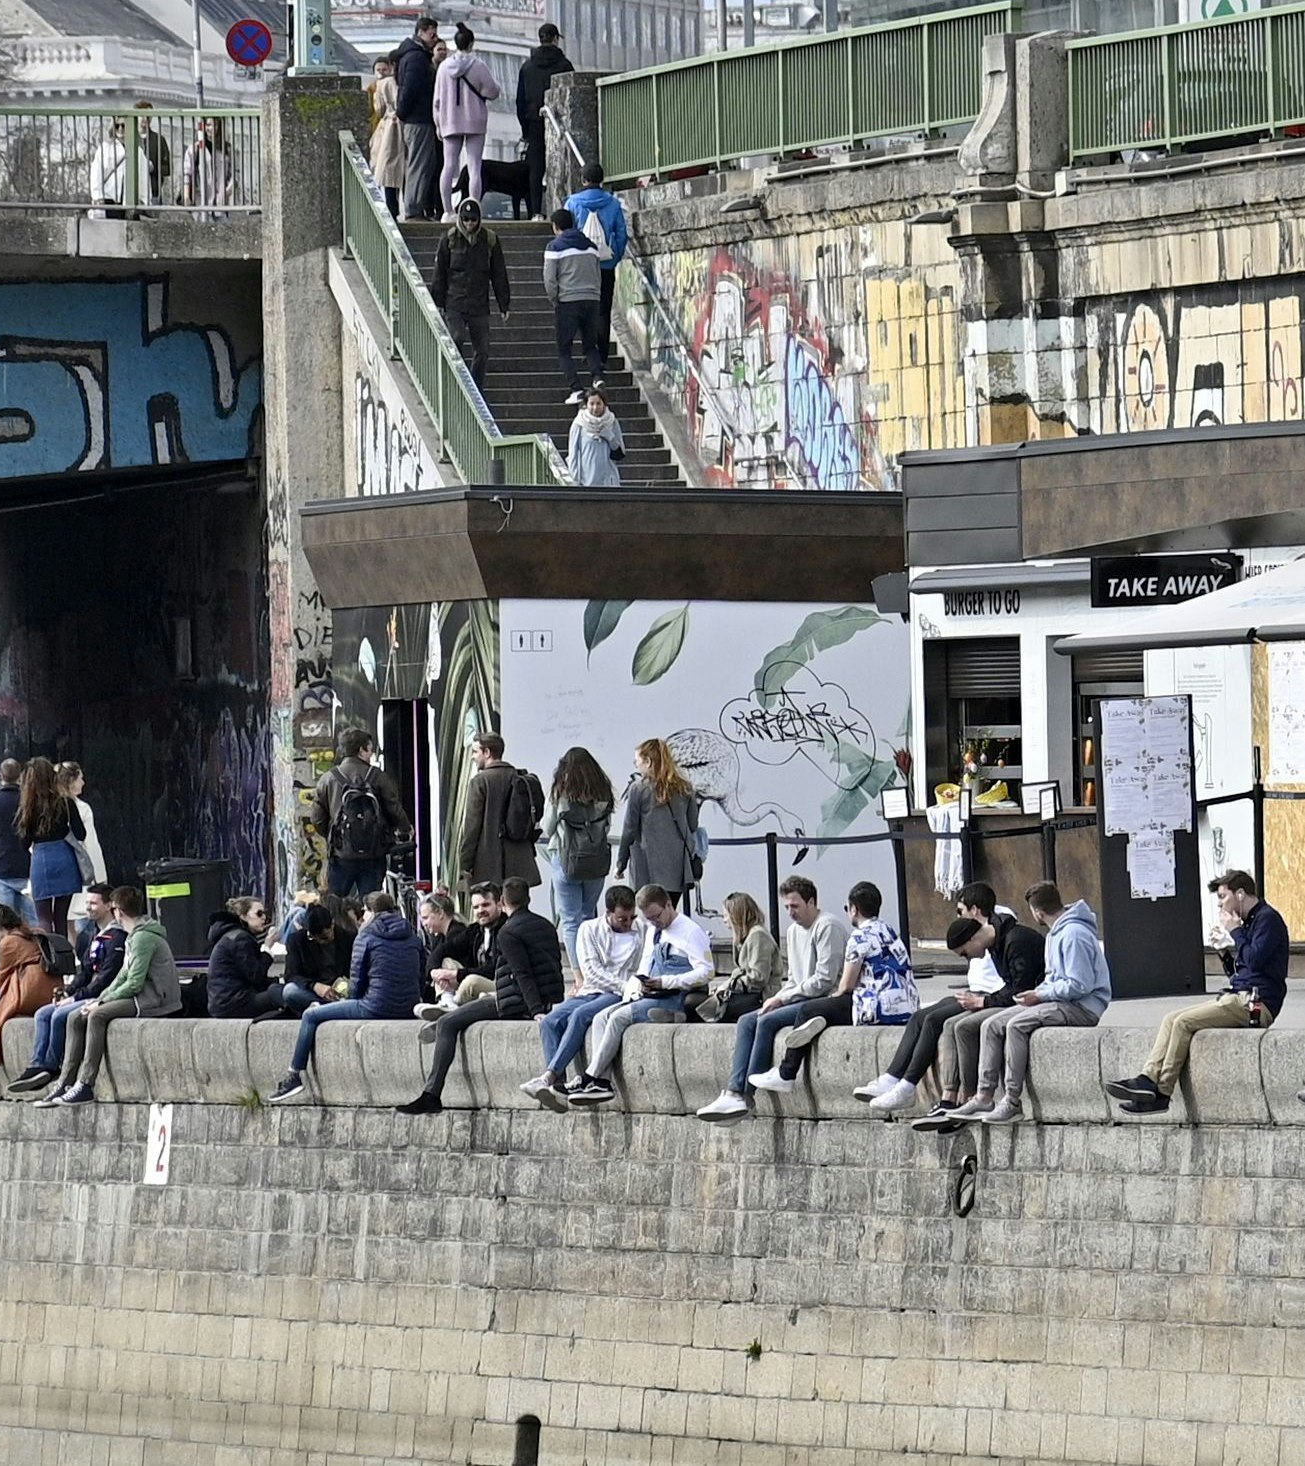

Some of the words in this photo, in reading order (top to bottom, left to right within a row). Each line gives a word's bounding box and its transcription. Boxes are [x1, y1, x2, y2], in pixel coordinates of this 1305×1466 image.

[1108, 577, 1158, 598] TAKE
[1162, 574, 1223, 597] AWAY
[944, 591, 985, 616] BURGER
[987, 590, 1002, 615] TO
[1004, 589, 1020, 614] GO
[156, 1124, 167, 1173] 2
